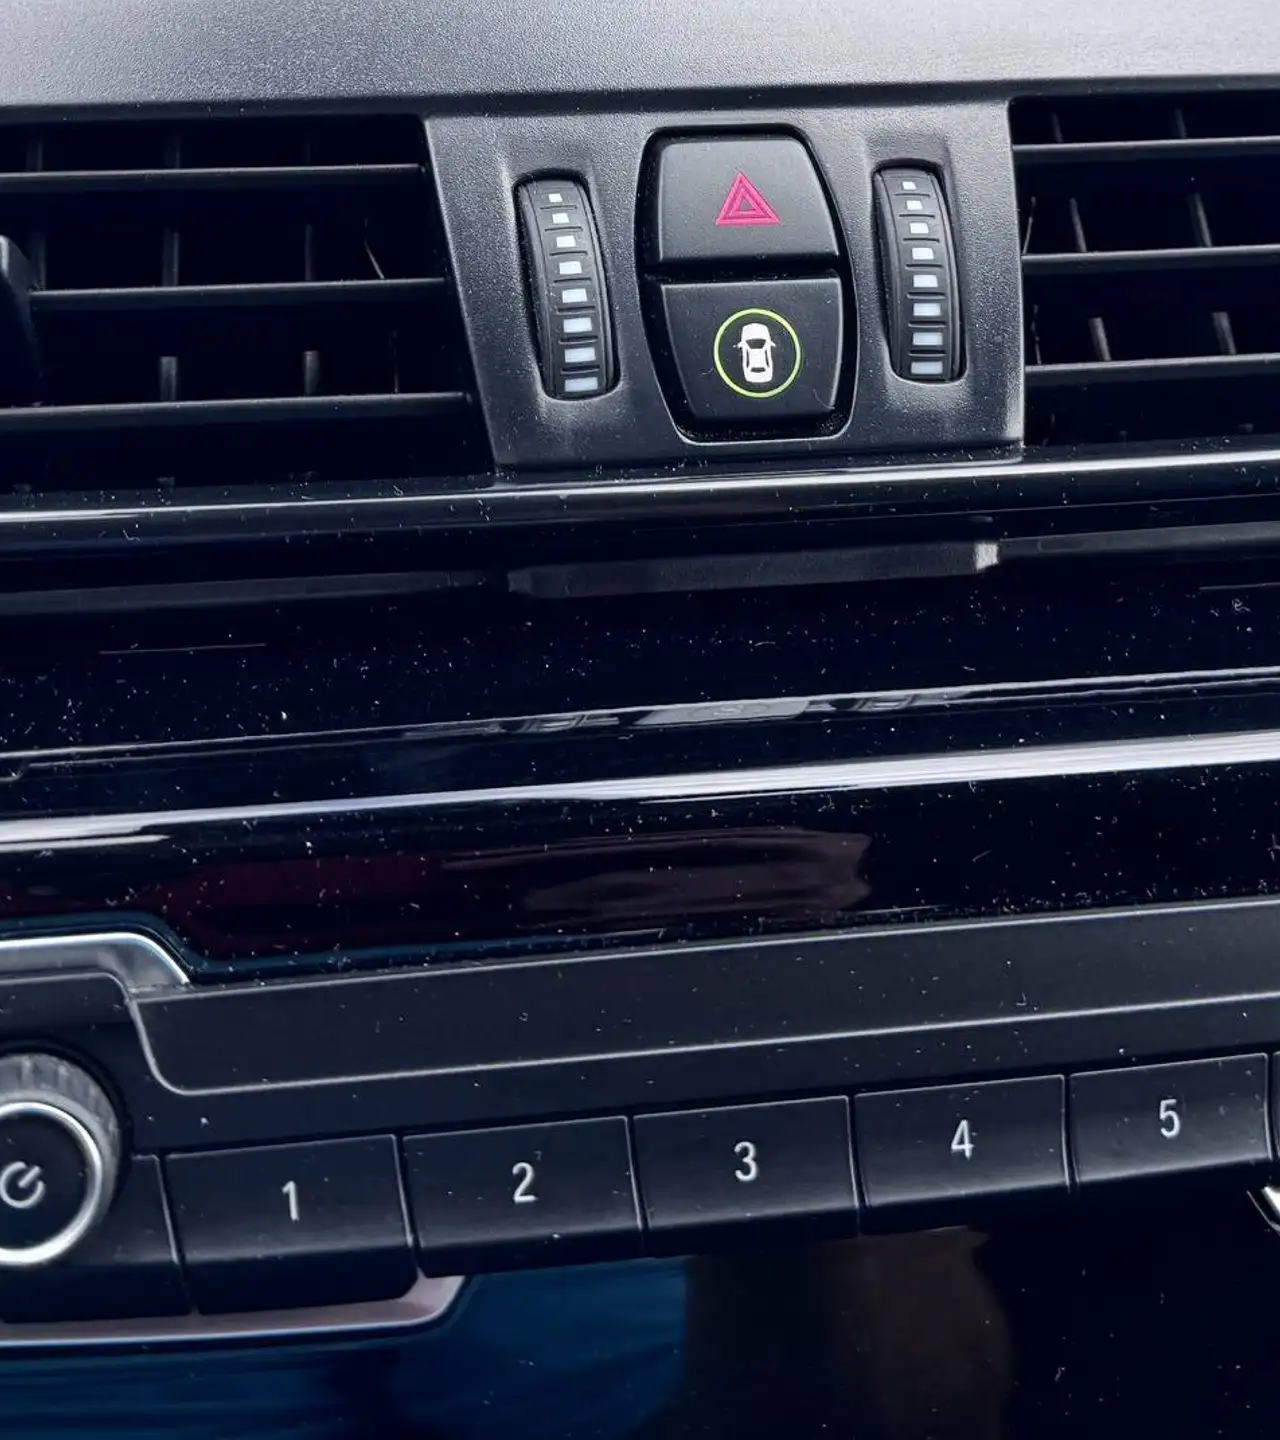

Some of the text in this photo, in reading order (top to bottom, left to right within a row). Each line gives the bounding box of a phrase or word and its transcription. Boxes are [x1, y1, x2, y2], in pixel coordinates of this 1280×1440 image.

[951, 1119, 975, 1159] 4
[1158, 1099, 1181, 1139] 5
[734, 1141, 758, 1183] 3
[281, 1181, 300, 1221] 1
[512, 1162, 538, 1204] 2
